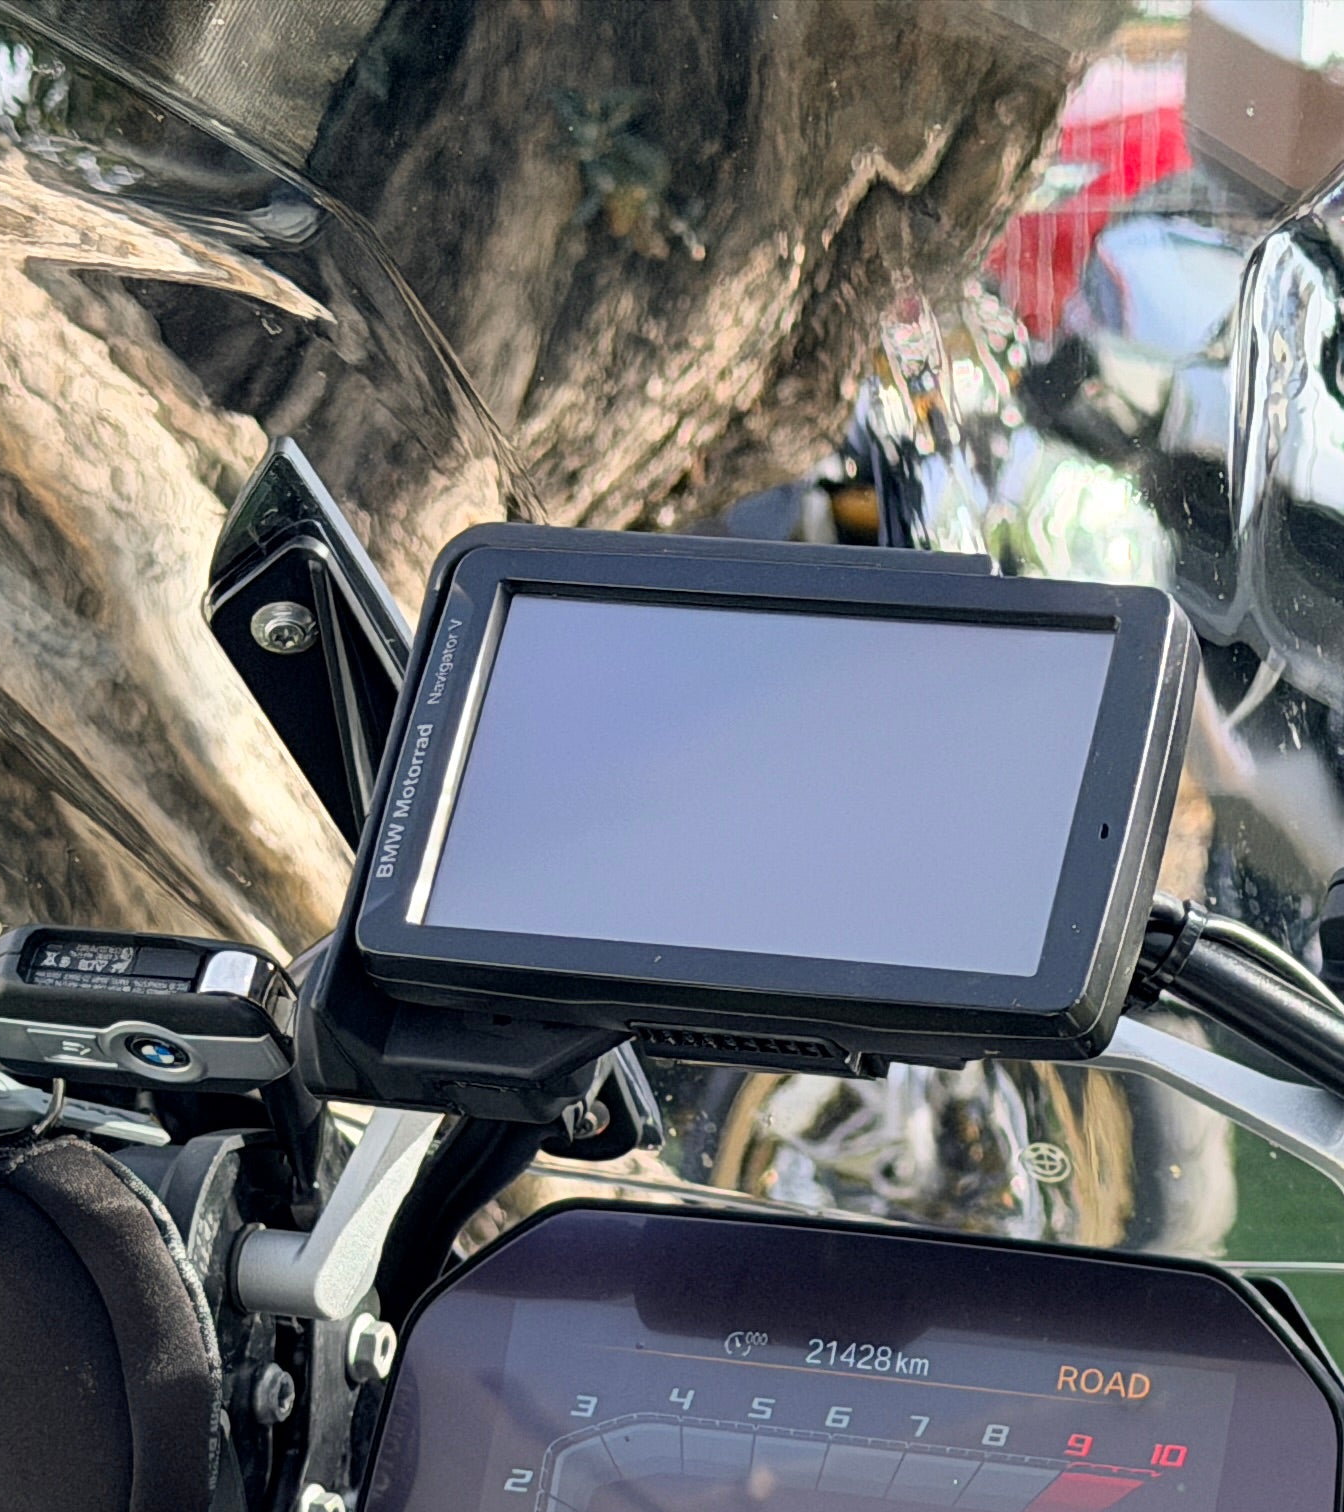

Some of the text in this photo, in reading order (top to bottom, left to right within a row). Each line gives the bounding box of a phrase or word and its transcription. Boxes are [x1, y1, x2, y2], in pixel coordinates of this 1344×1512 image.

[427, 633, 458, 705] Navigator
[376, 723, 433, 878] BMW Motorrad
[1056, 1365, 1151, 1400] ROAD
[571, 1388, 1187, 1468] 3 4 5 6 7 8 9 10
[504, 1469, 533, 1493] 2
